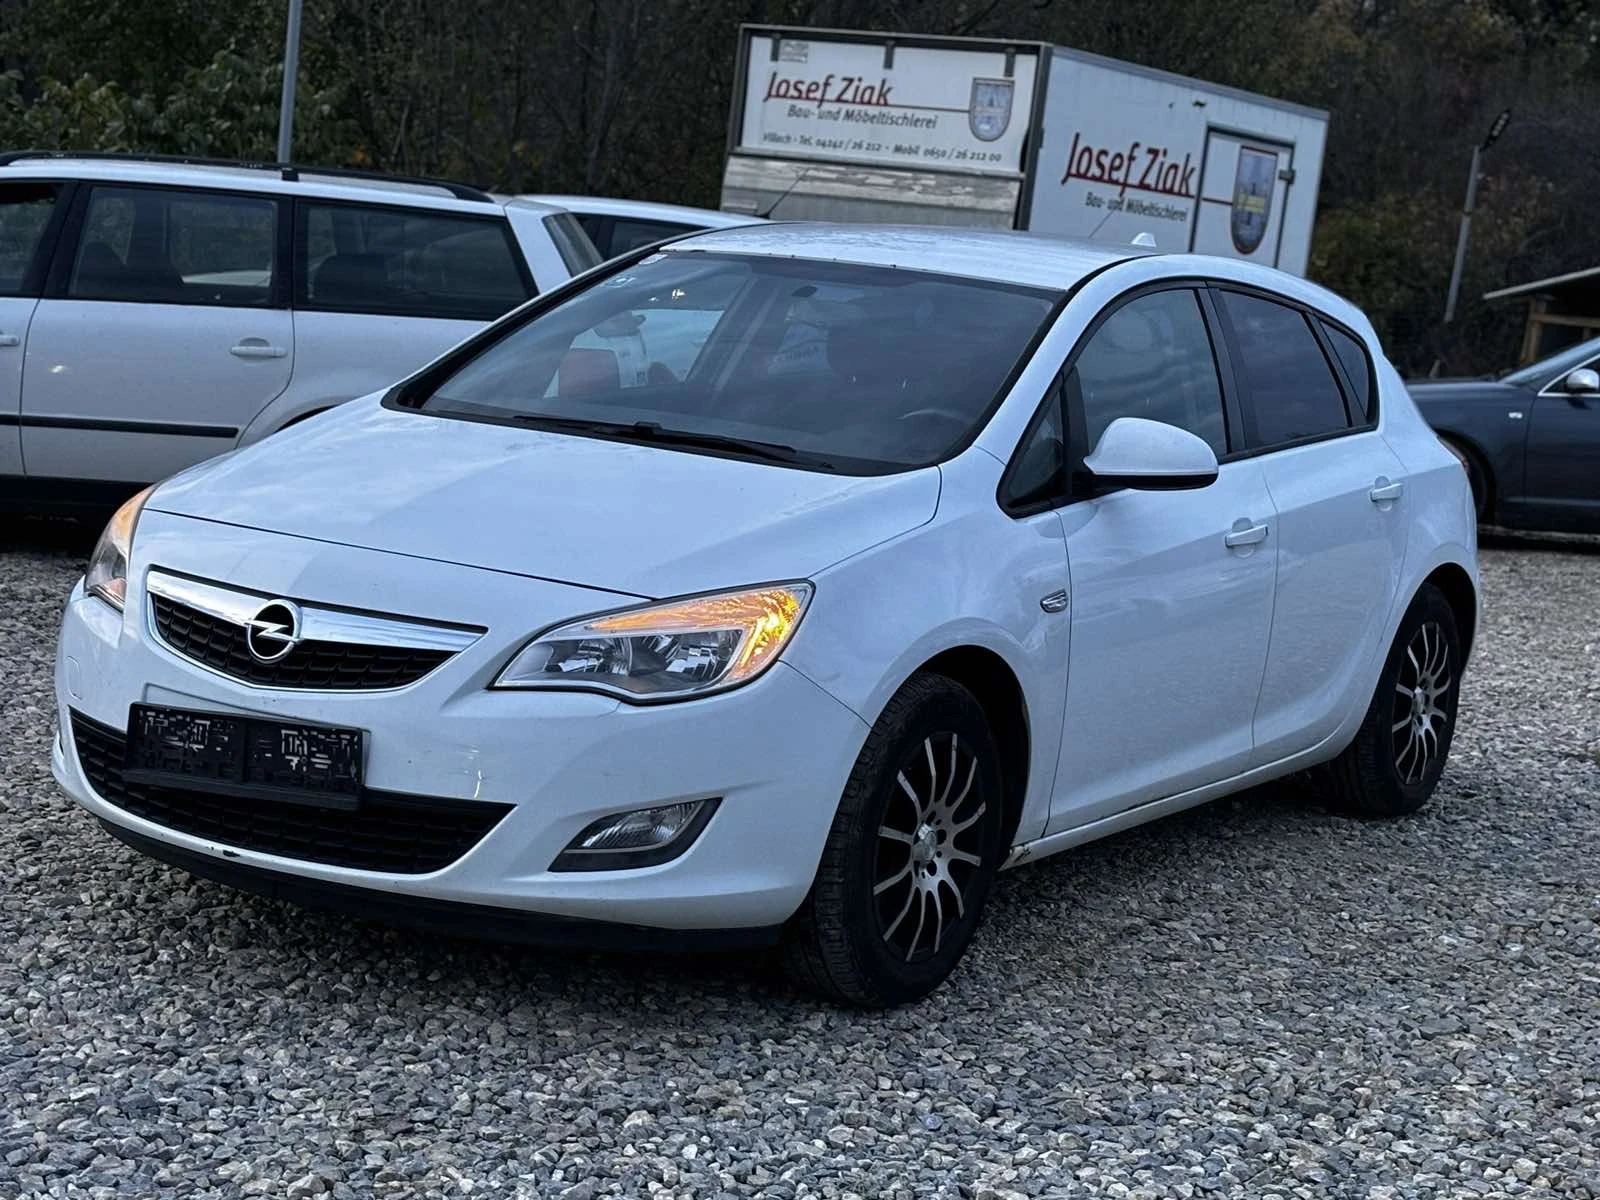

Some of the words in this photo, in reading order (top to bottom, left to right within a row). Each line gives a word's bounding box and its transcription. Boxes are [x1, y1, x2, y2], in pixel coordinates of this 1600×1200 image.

[763, 71, 835, 108] Josef
[837, 77, 894, 106] Ziak
[788, 105, 815, 118] Bau-
[817, 107, 842, 121] und
[843, 109, 938, 128] Möbeltischlerei
[1061, 132, 1141, 198] Josef
[1139, 147, 1197, 198] Ziak
